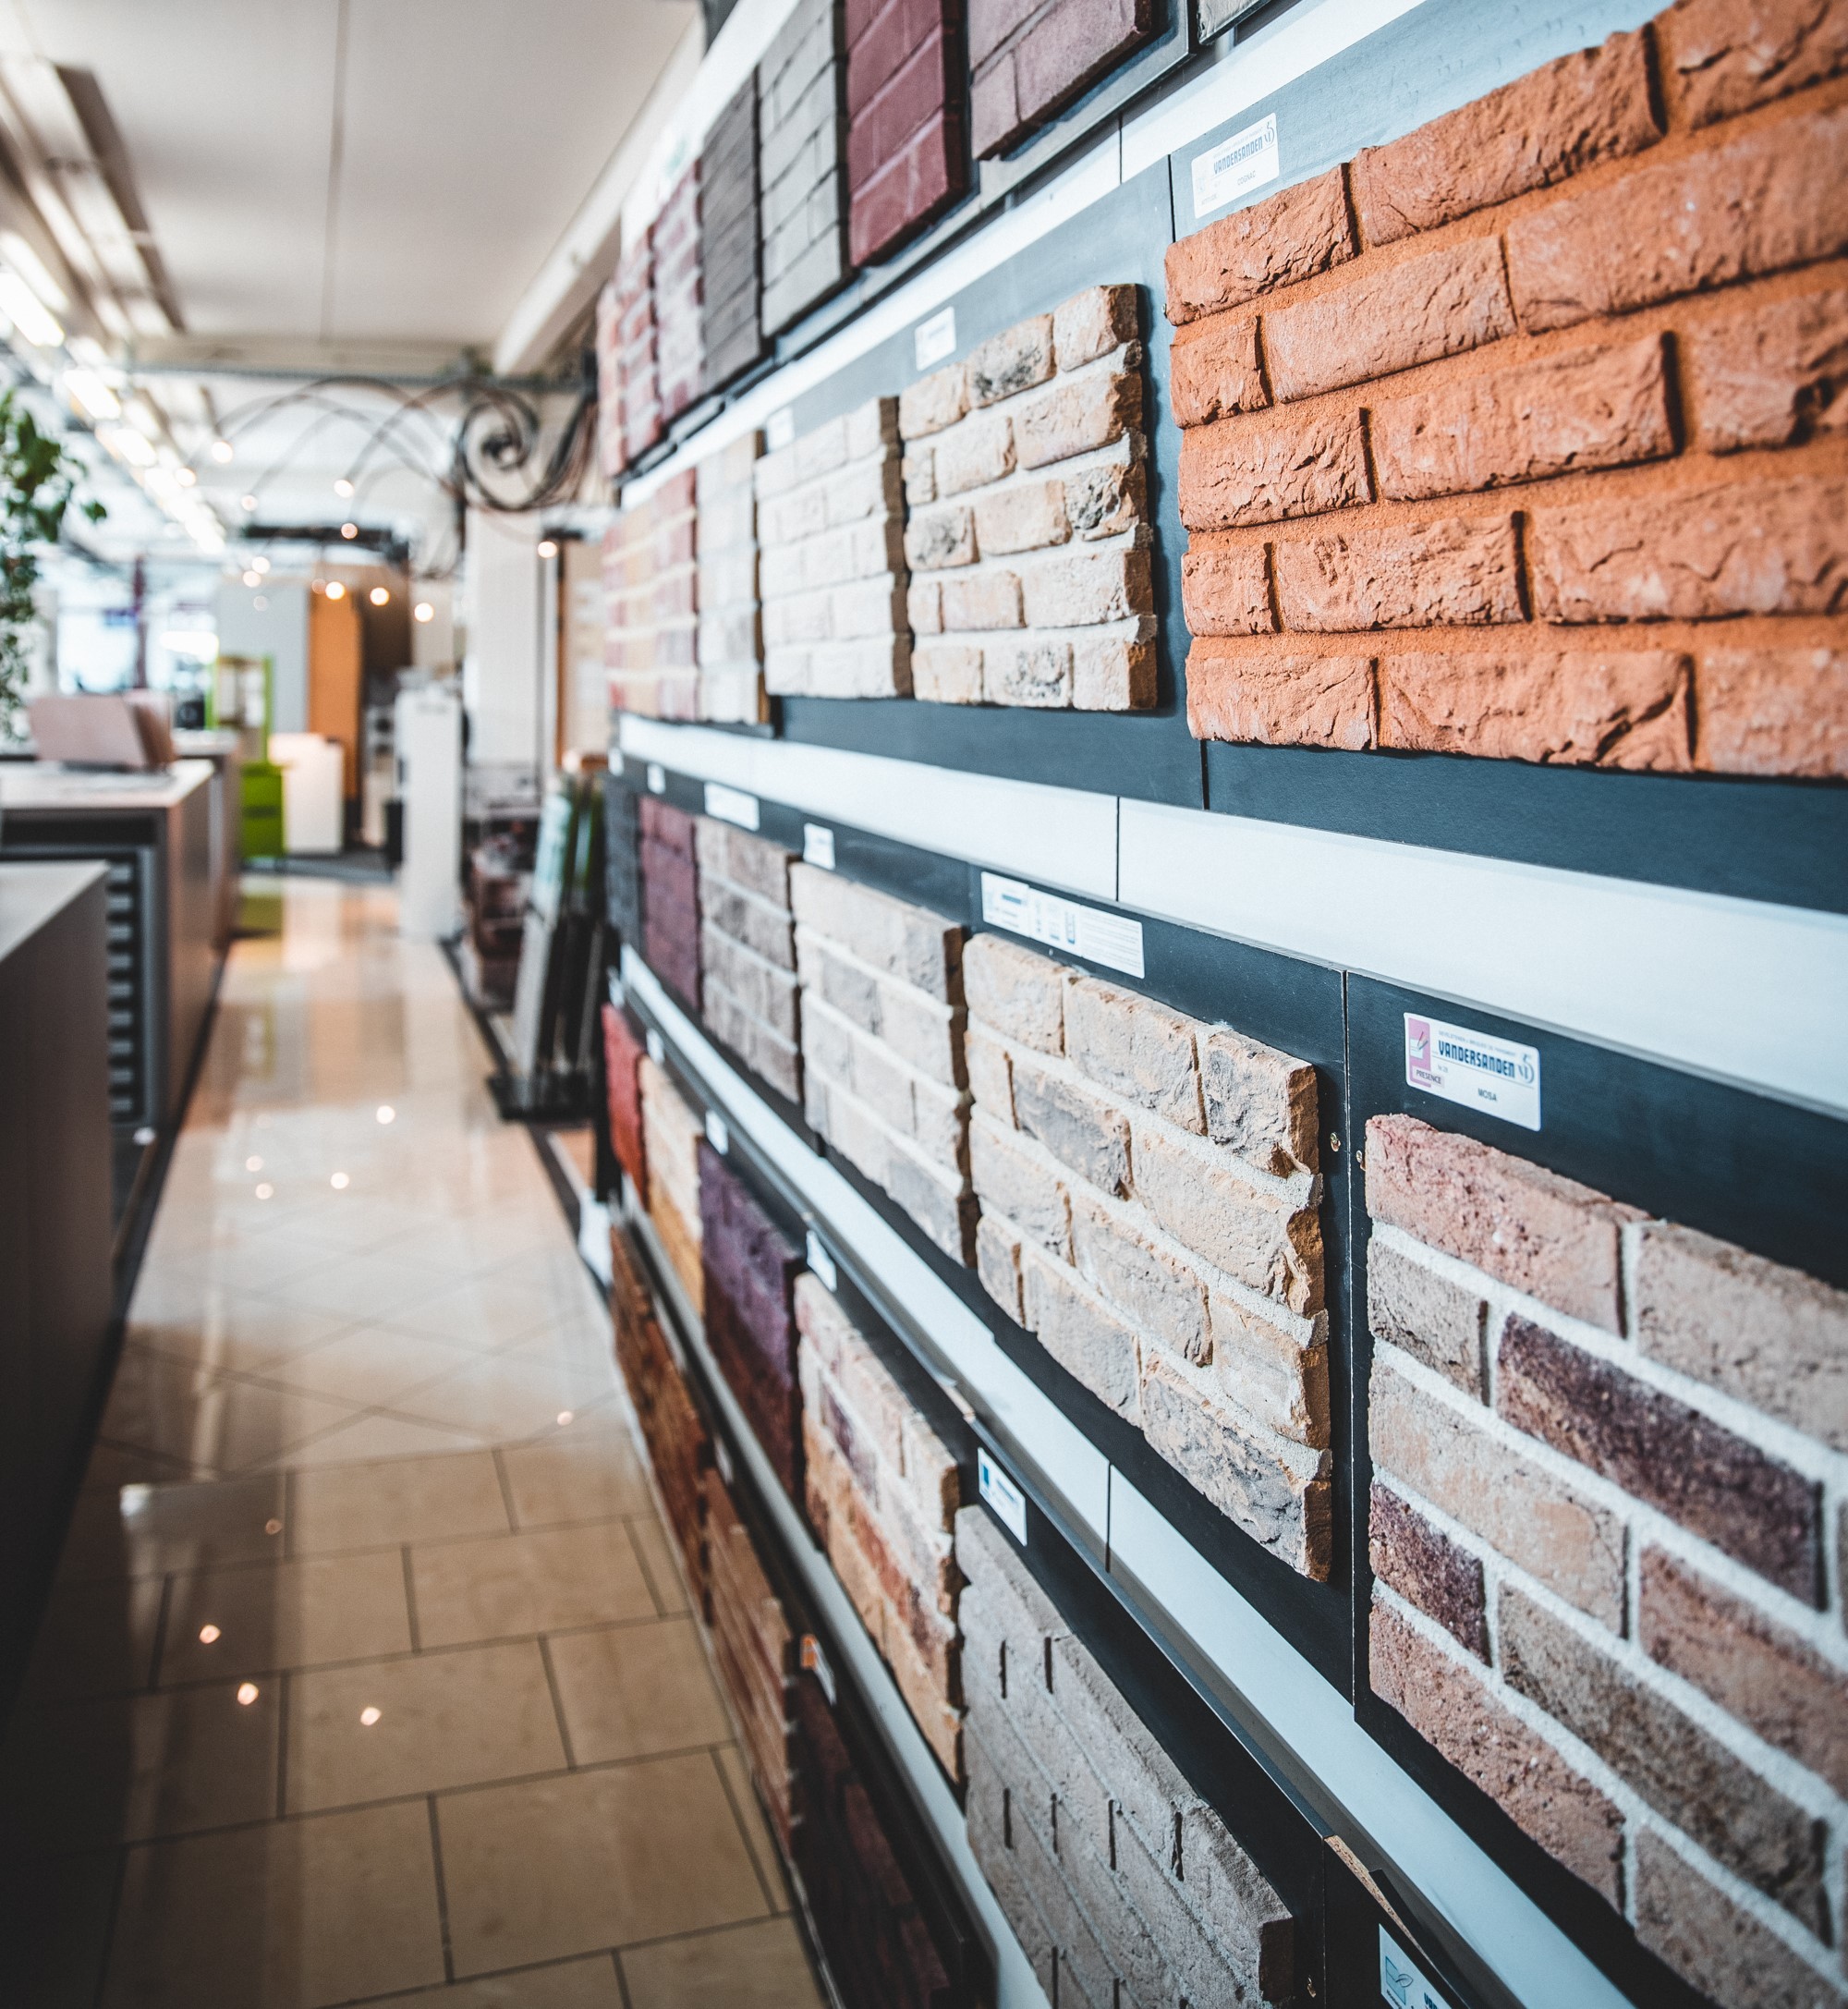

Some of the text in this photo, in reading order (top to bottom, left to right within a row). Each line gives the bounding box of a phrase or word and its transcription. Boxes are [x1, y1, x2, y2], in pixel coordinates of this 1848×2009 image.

[1213, 136, 1263, 175] VANDERSANDEN
[1416, 1069, 1441, 1085] PRESENCE
[1438, 1040, 1515, 1079] VANDERSANDEN
